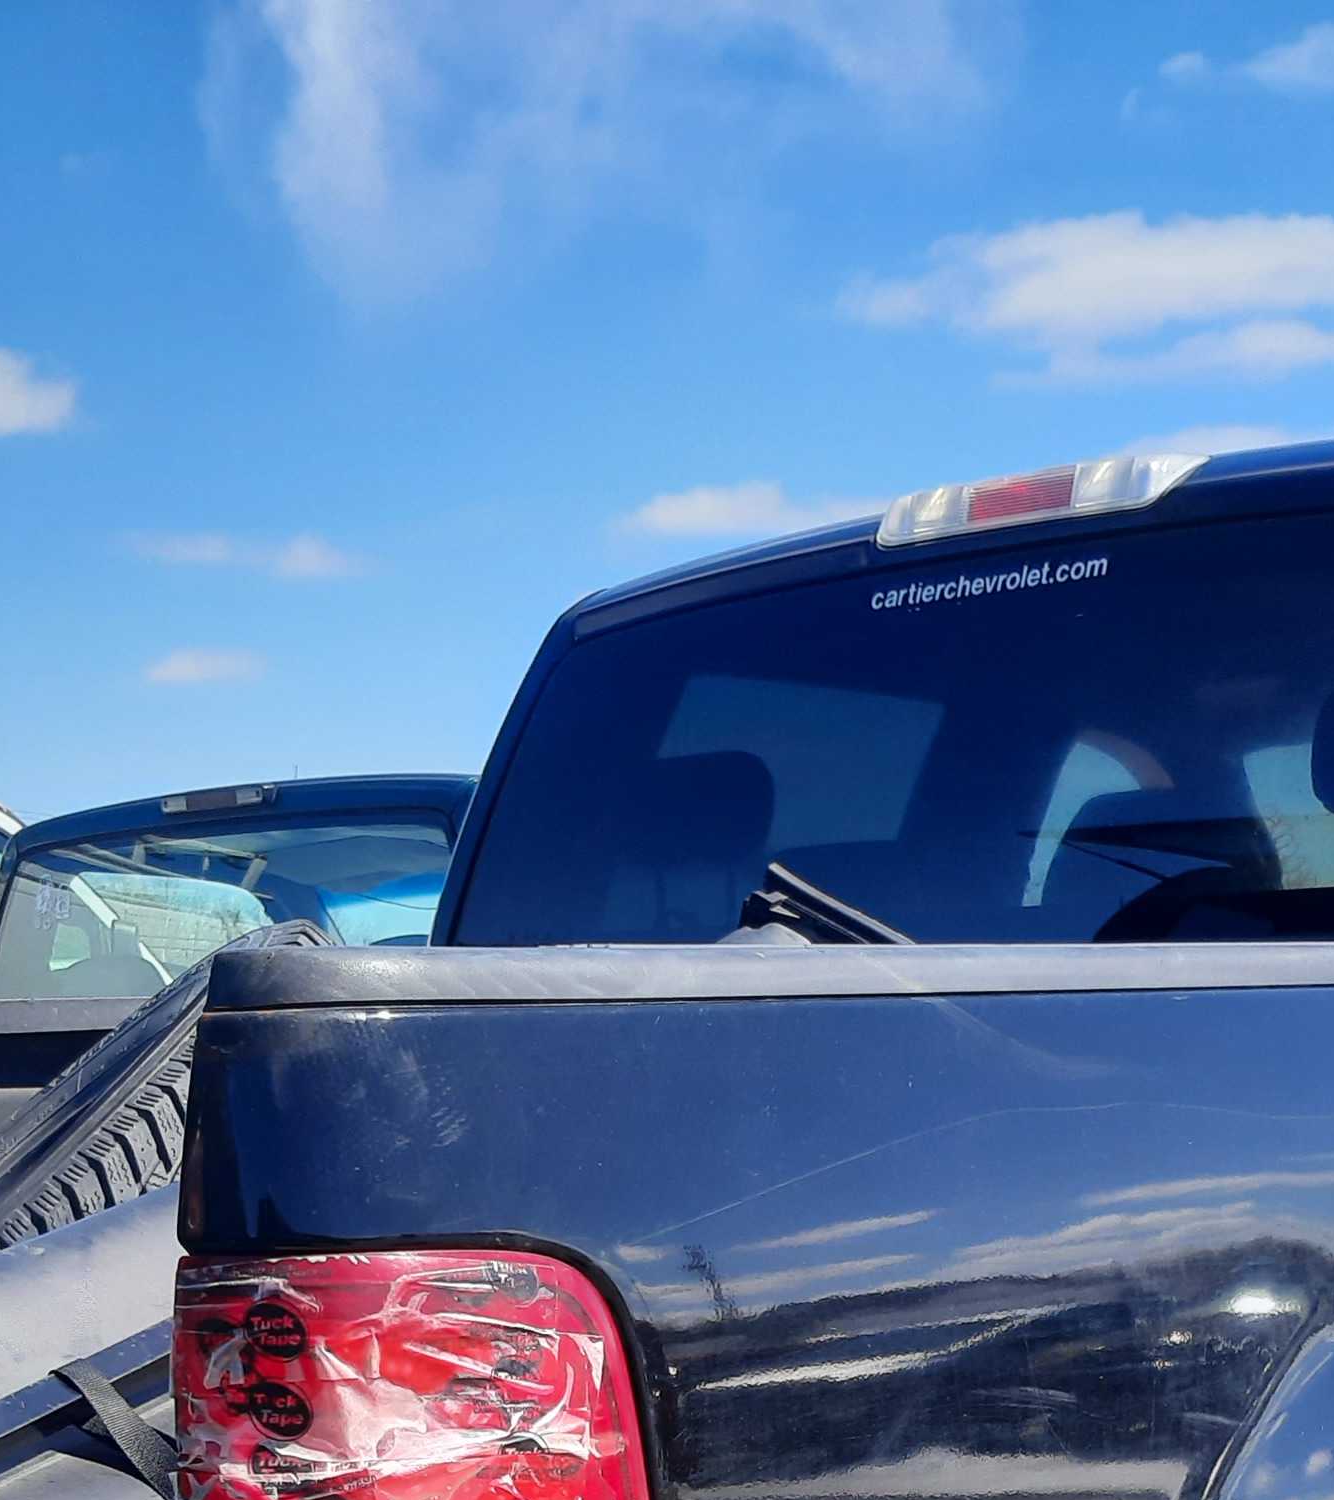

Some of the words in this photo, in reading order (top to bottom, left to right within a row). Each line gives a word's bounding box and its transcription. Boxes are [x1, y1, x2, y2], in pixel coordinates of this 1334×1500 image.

[871, 557, 1109, 609] cartierchevrolet.com
[250, 1314, 294, 1331] Tuck
[254, 1393, 297, 1409] Tck
